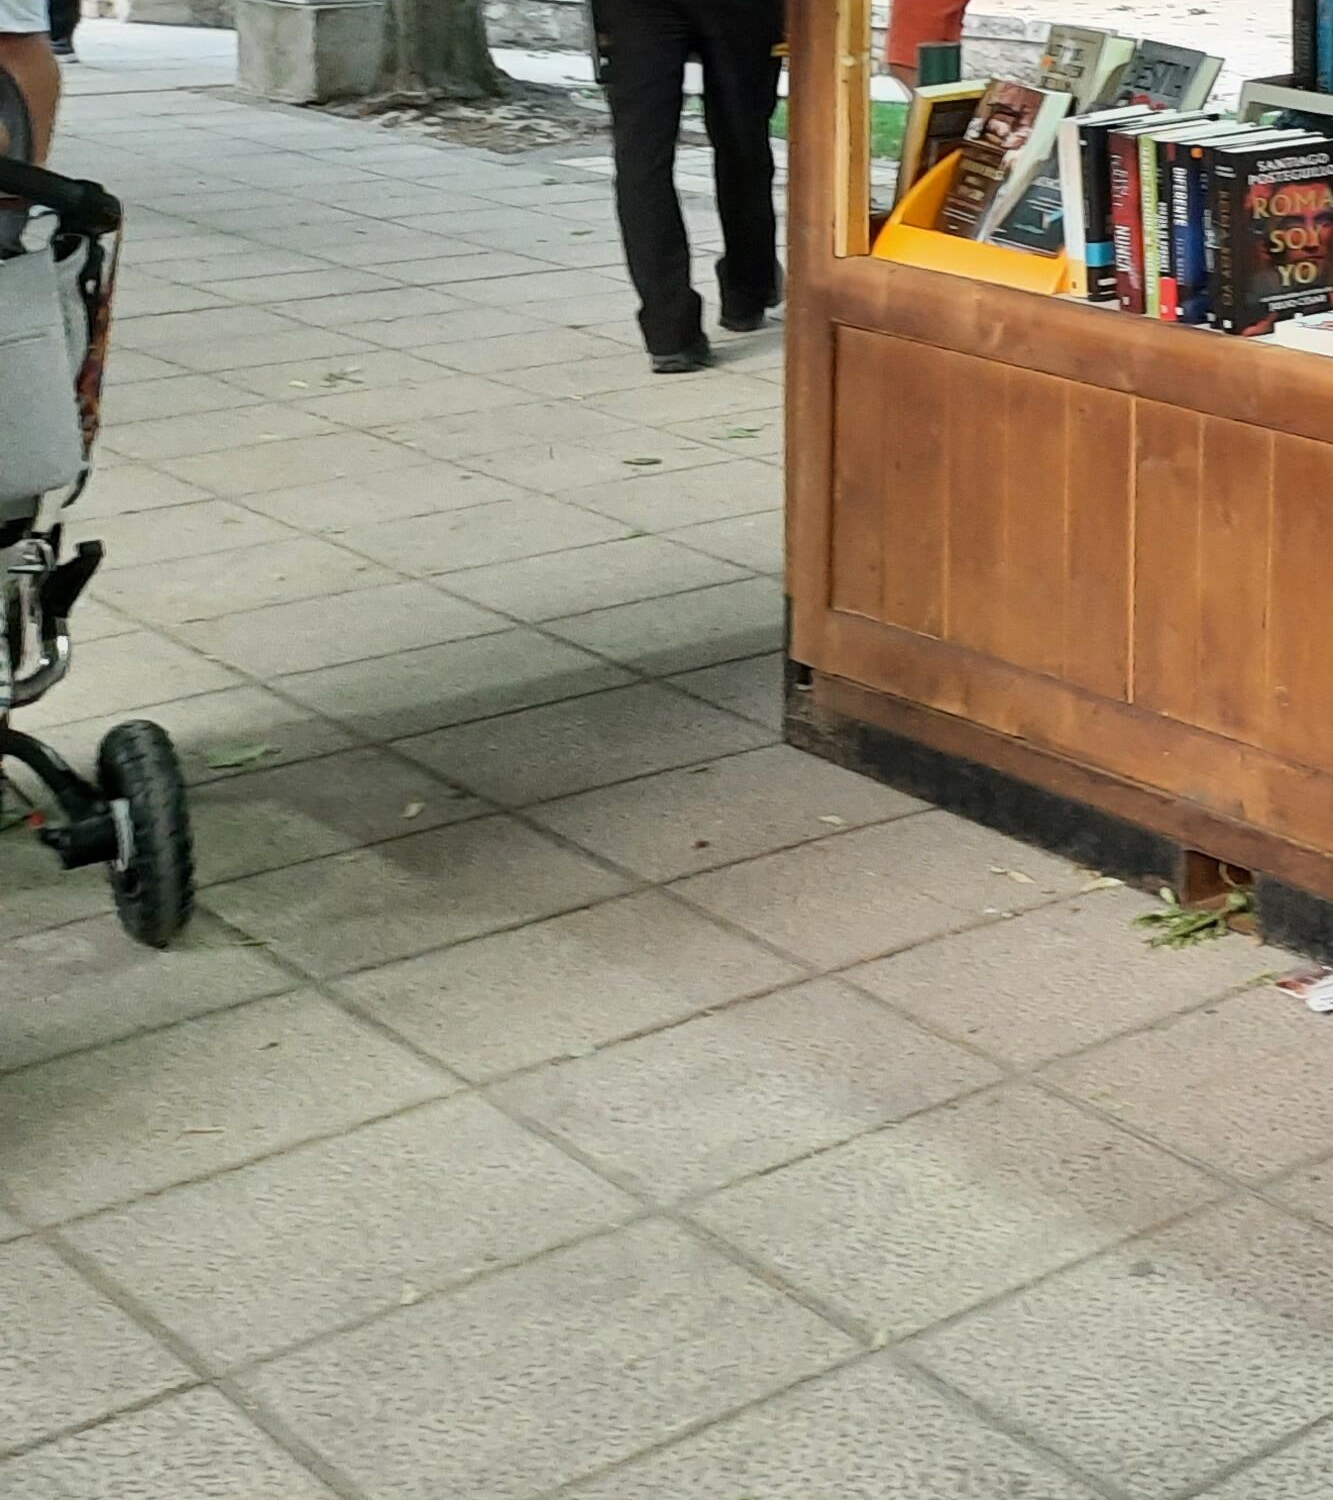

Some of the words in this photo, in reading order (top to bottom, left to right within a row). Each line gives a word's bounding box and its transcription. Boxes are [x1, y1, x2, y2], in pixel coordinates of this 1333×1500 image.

[1256, 153, 1331, 173] SANTIAGO
[1113, 225, 1133, 272] NUNCA
[1269, 226, 1322, 254] SOY
[1277, 260, 1318, 287] YO
